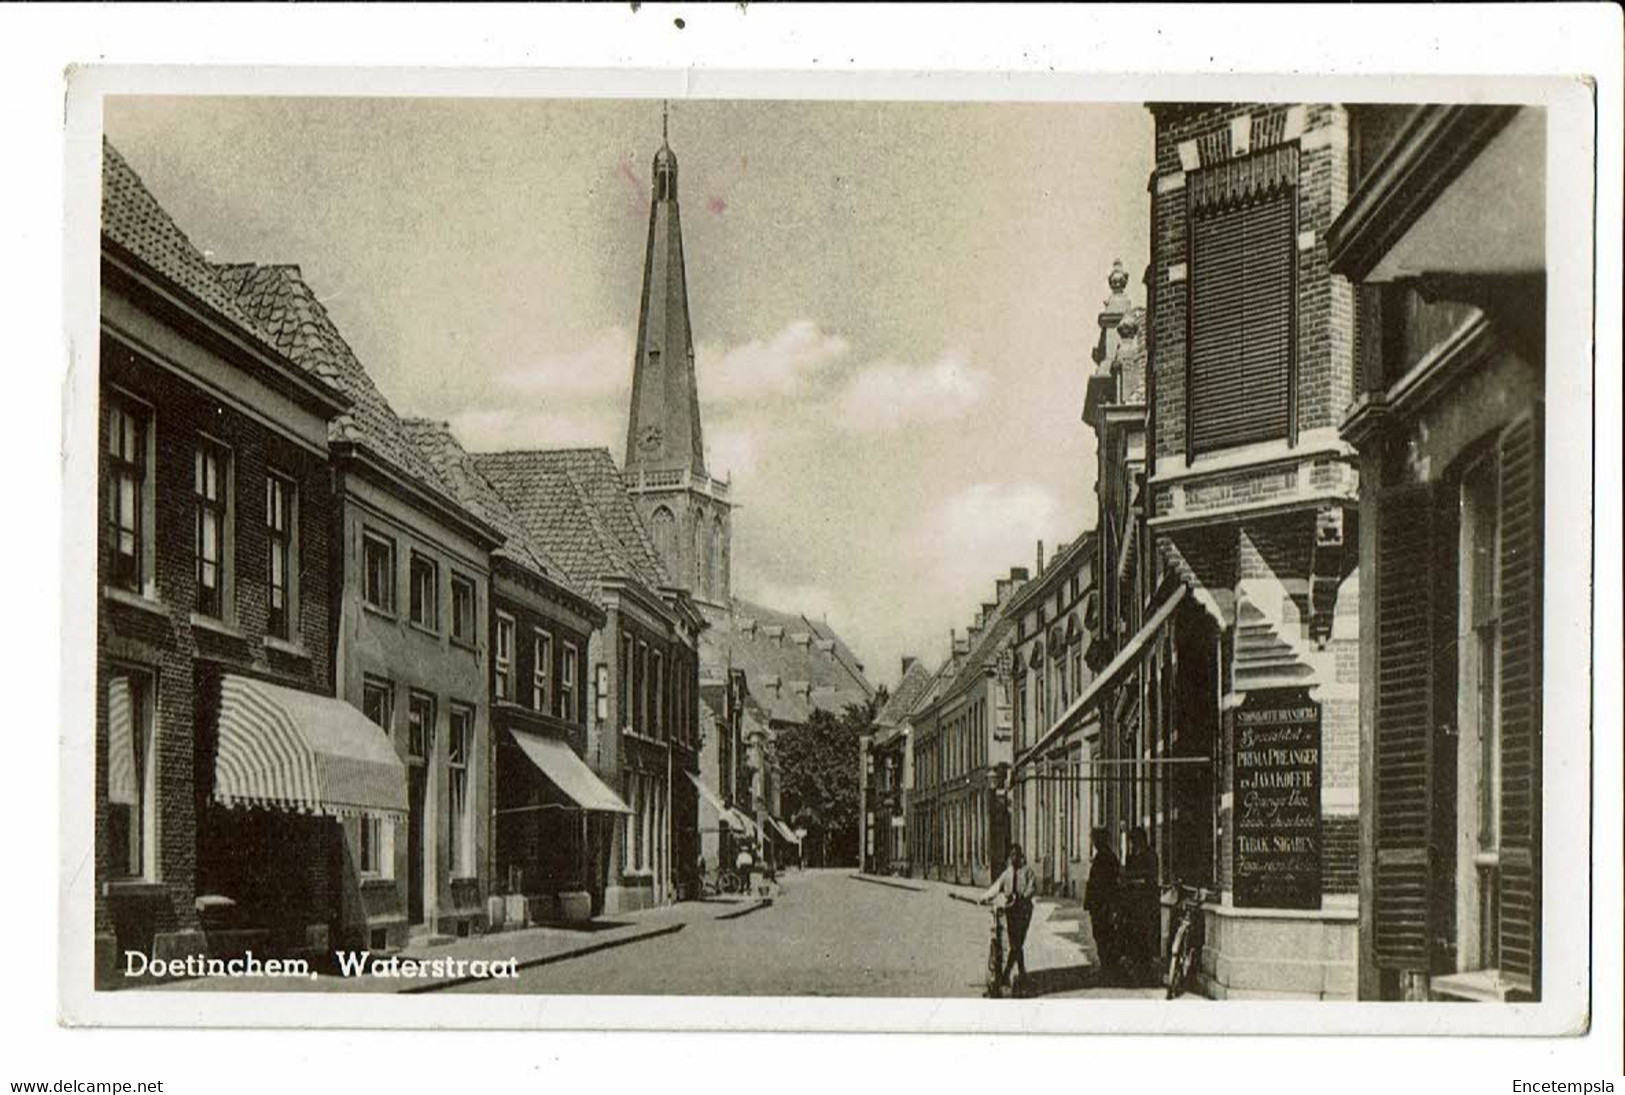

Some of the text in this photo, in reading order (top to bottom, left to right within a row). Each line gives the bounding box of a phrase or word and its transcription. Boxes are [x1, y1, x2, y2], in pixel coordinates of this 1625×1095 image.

[1237, 749, 1318, 767] PRIMA PREANGER
[1237, 836, 1269, 852] TABAK
